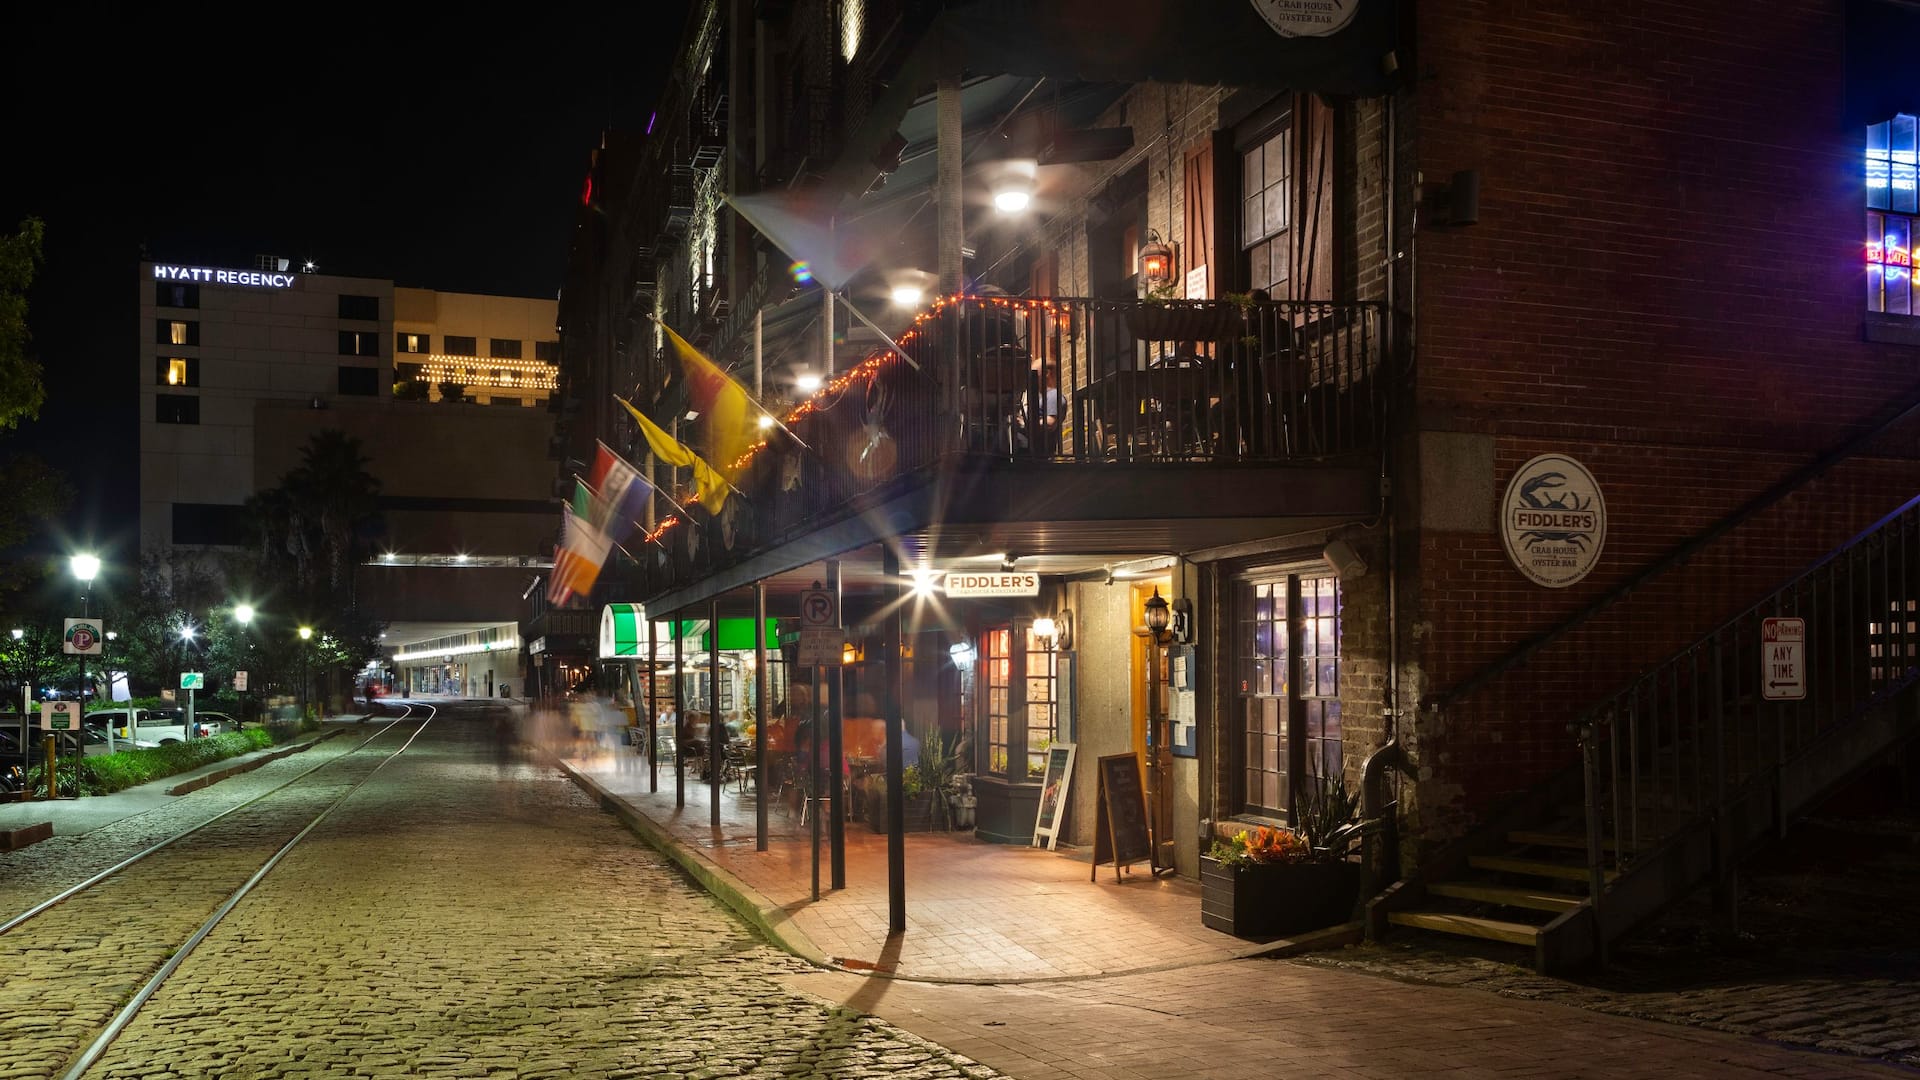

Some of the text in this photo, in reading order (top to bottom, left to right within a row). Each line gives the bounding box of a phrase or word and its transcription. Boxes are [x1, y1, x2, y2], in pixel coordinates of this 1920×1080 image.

[1304, 1, 1333, 11] HOUSE
[1279, 12, 1332, 24] OYSTER BAR
[155, 265, 295, 288] HYATT REGENCY
[1518, 513, 1592, 529] FIDDLER'S
[1531, 545, 1578, 555] CRAB HOUSE
[1532, 558, 1577, 568] OYSTER BAR
[950, 576, 1034, 588] FIDDLER'S
[1764, 623, 1776, 640] NO
[77, 633, 90, 647] P
[1773, 646, 1792, 661] ANY
[1773, 663, 1794, 679] TIME
